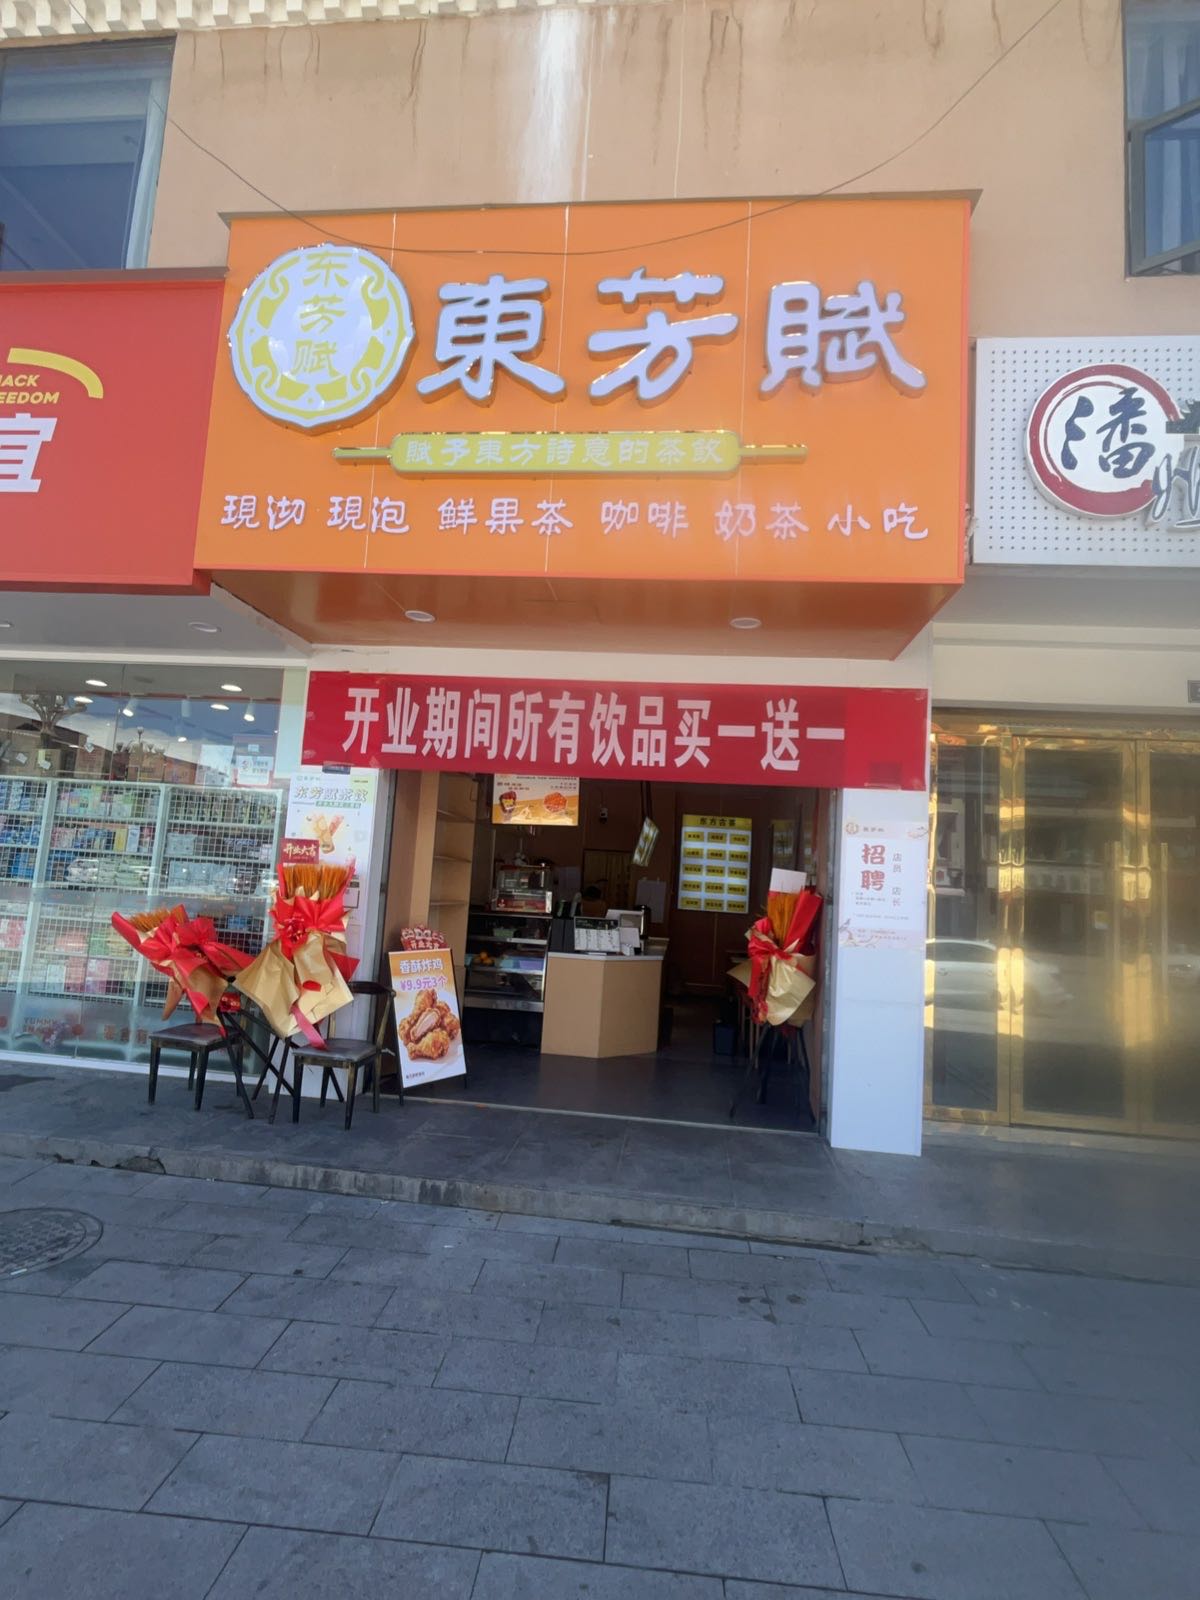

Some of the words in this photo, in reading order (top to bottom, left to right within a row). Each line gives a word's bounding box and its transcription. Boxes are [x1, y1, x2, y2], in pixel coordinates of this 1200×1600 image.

[416, 268, 927, 402] 東芳賦
[0, 374, 40, 387] ACK
[1061, 387, 1156, 479] 潘
[600, 500, 689, 538] 咖啡
[714, 500, 809, 540] 奶茶
[827, 502, 929, 540] 小吃
[342, 687, 845, 771] 开业期间所有饮品买一送一
[861, 843, 886, 891] 招聘
